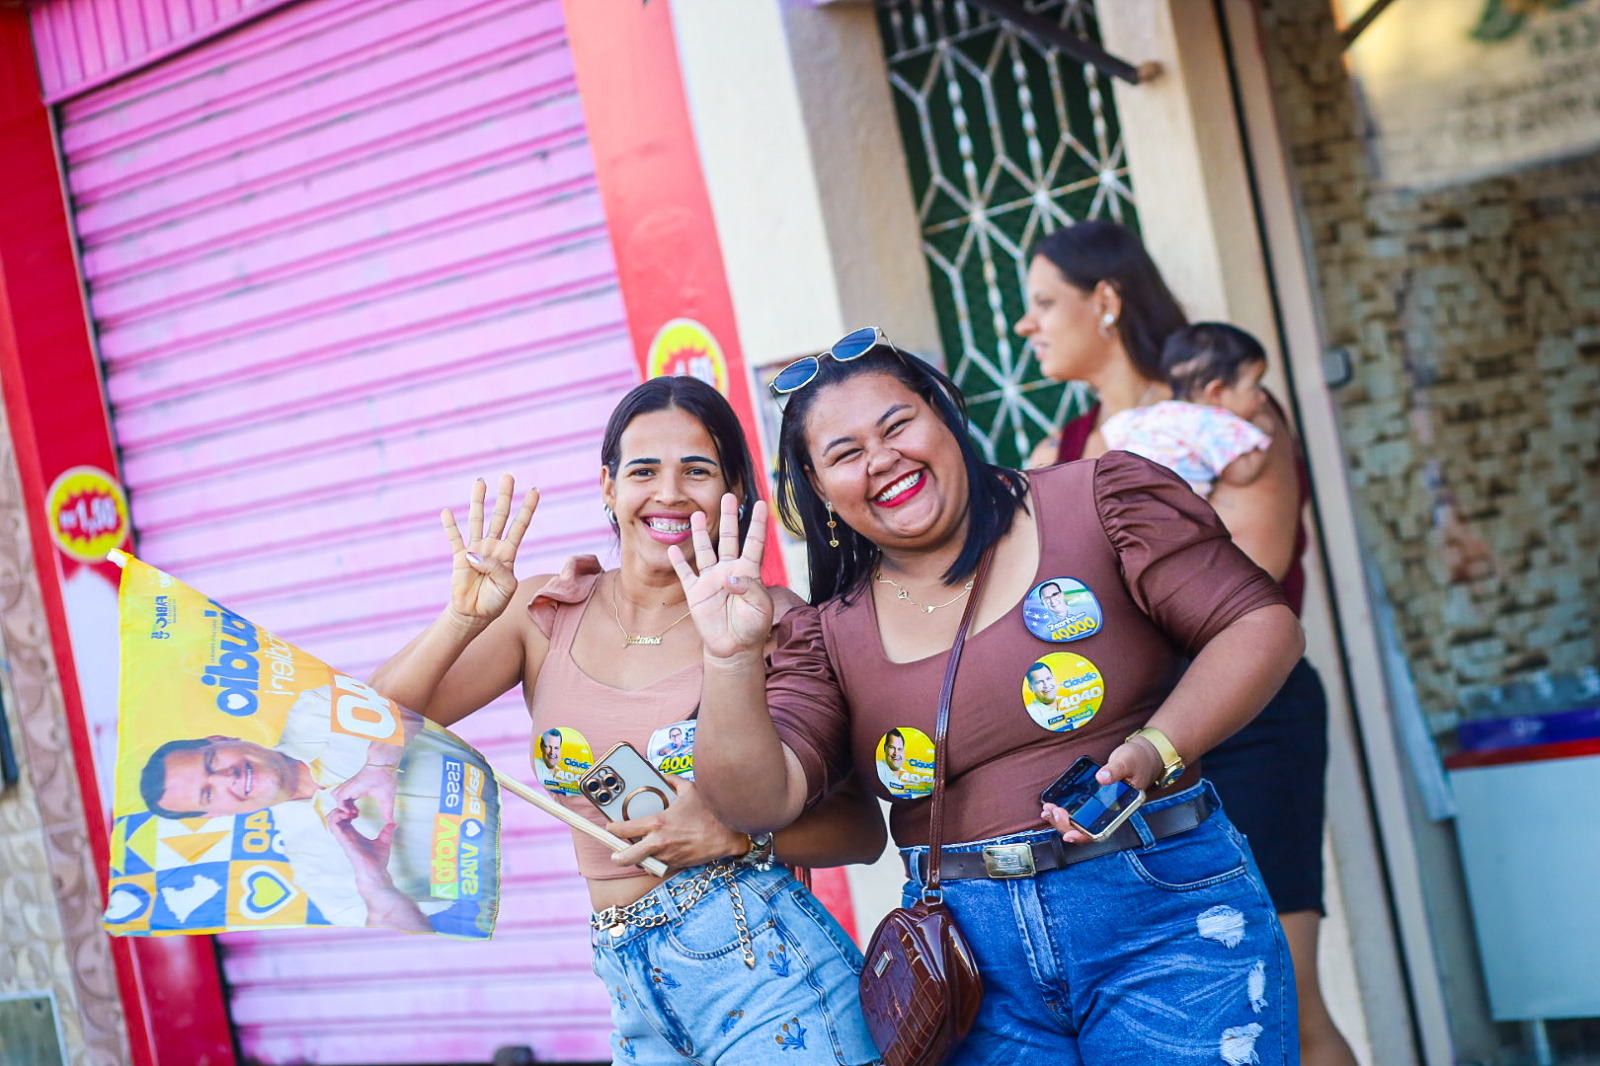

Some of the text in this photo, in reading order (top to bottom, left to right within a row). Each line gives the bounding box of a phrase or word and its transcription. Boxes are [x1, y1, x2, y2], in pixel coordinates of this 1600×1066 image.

[1052, 616, 1096, 640] 40000
[1060, 686, 1103, 708] 4040
[659, 755, 694, 772] 400
